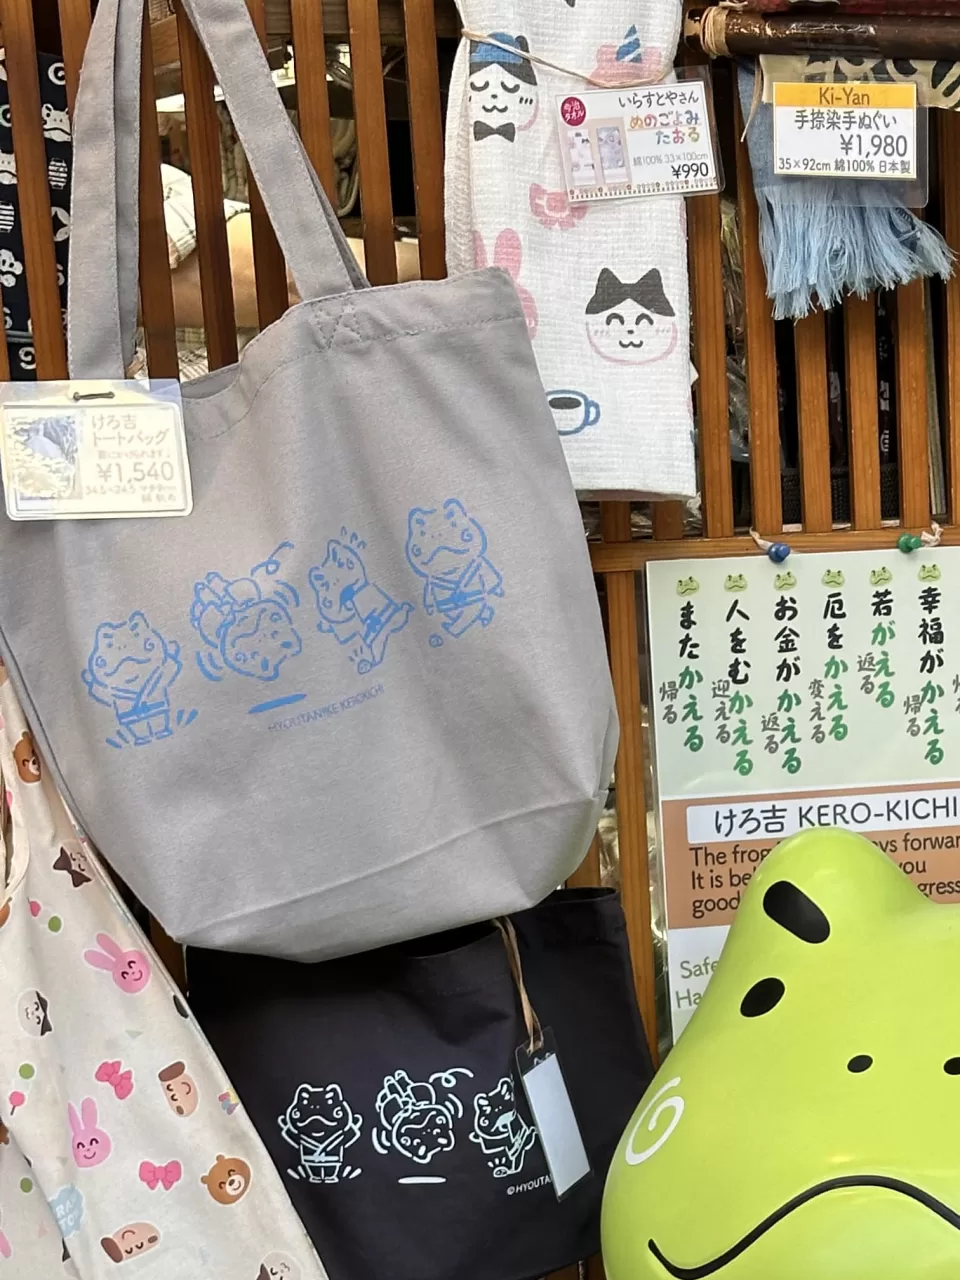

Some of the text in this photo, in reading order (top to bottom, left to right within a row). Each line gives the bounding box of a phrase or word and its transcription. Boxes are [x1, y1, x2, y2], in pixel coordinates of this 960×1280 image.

[619, 90, 699, 108] いらすとやさん
[819, 87, 870, 105] Ki-Yan
[655, 127, 700, 145] たおる
[795, 108, 897, 131] 手捺染手ぬぐい
[840, 134, 908, 159] ¥1,980
[671, 162, 709, 180] ¥990
[779, 158, 912, 174] 35×92cm 綿100% 日本製
[91, 413, 137, 431] けろ吉
[92, 428, 170, 447] トートバッグ
[96, 461, 174, 484] ¥1,540
[823, 592, 849, 741] 厄をかえる
[871, 589, 896, 709] 若がえる
[678, 601, 704, 752] またかえる
[726, 599, 754, 776] 人をむかえる
[774, 595, 802, 775] お金がかえる
[857, 652, 875, 695] 返る
[918, 586, 945, 766] 幸福がかえる
[659, 681, 679, 725] 帰る
[711, 679, 731, 744] 迎える
[808, 678, 826, 744] 変える
[903, 694, 921, 738] 帰る
[761, 712, 781, 754] 返る
[715, 796, 958, 837] けろ吉 KERO-KICHI
[689, 846, 727, 867] The
[691, 870, 705, 890] It
[710, 869, 724, 889] is
[899, 860, 927, 875] ou
[692, 890, 740, 919] good
